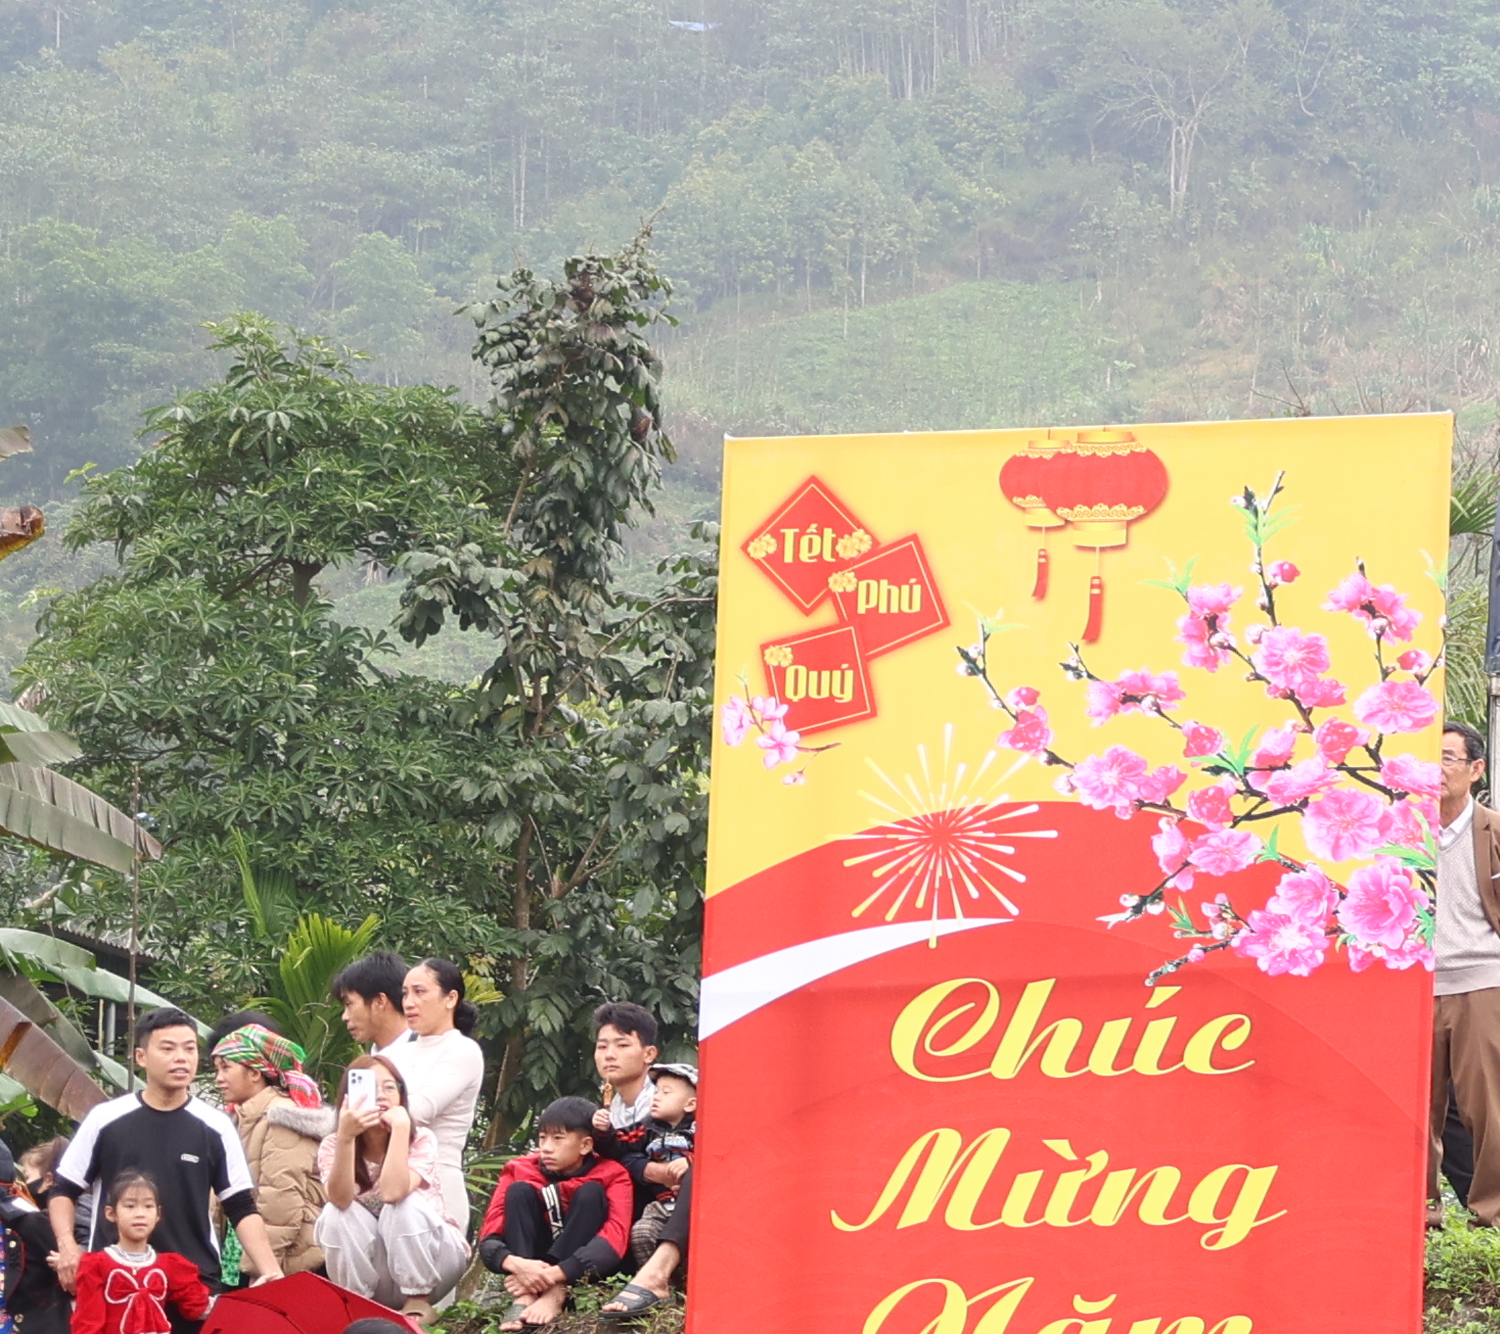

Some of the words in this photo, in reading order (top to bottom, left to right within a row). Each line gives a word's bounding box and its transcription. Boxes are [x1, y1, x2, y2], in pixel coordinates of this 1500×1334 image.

[780, 523, 836, 563] Tết
[857, 578, 921, 614] Phú
[784, 663, 854, 703] Quý
[891, 977, 1255, 1083] Chúc
[831, 1127, 1288, 1251] Mừng
